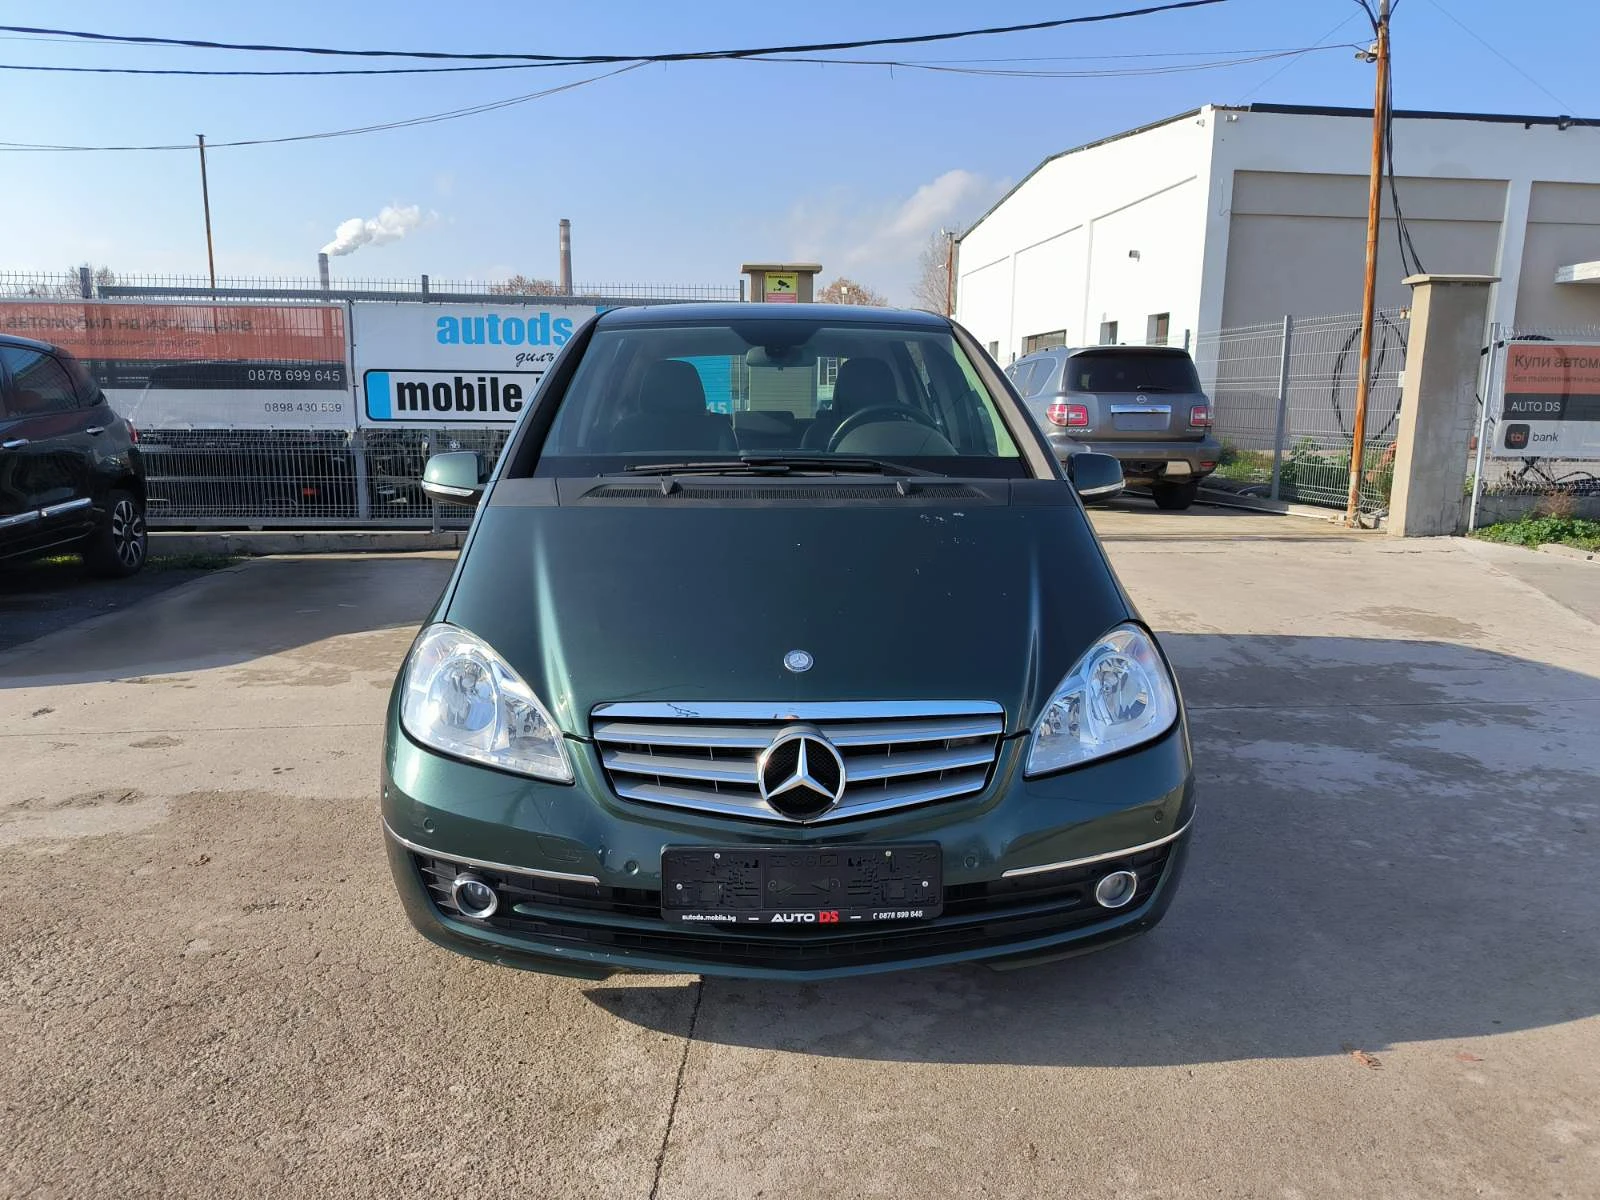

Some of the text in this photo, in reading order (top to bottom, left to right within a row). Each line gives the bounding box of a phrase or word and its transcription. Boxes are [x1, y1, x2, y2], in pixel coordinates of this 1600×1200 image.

[436, 312, 573, 346] autods
[1514, 354, 1551, 370] Купи
[248, 369, 340, 382] 0878 699 645
[264, 402, 342, 413] 0898 430 539
[1511, 401, 1561, 413] AUTO DS
[1532, 431, 1559, 442] bank
[770, 912, 816, 923] AUTO
[818, 911, 840, 924] DS
